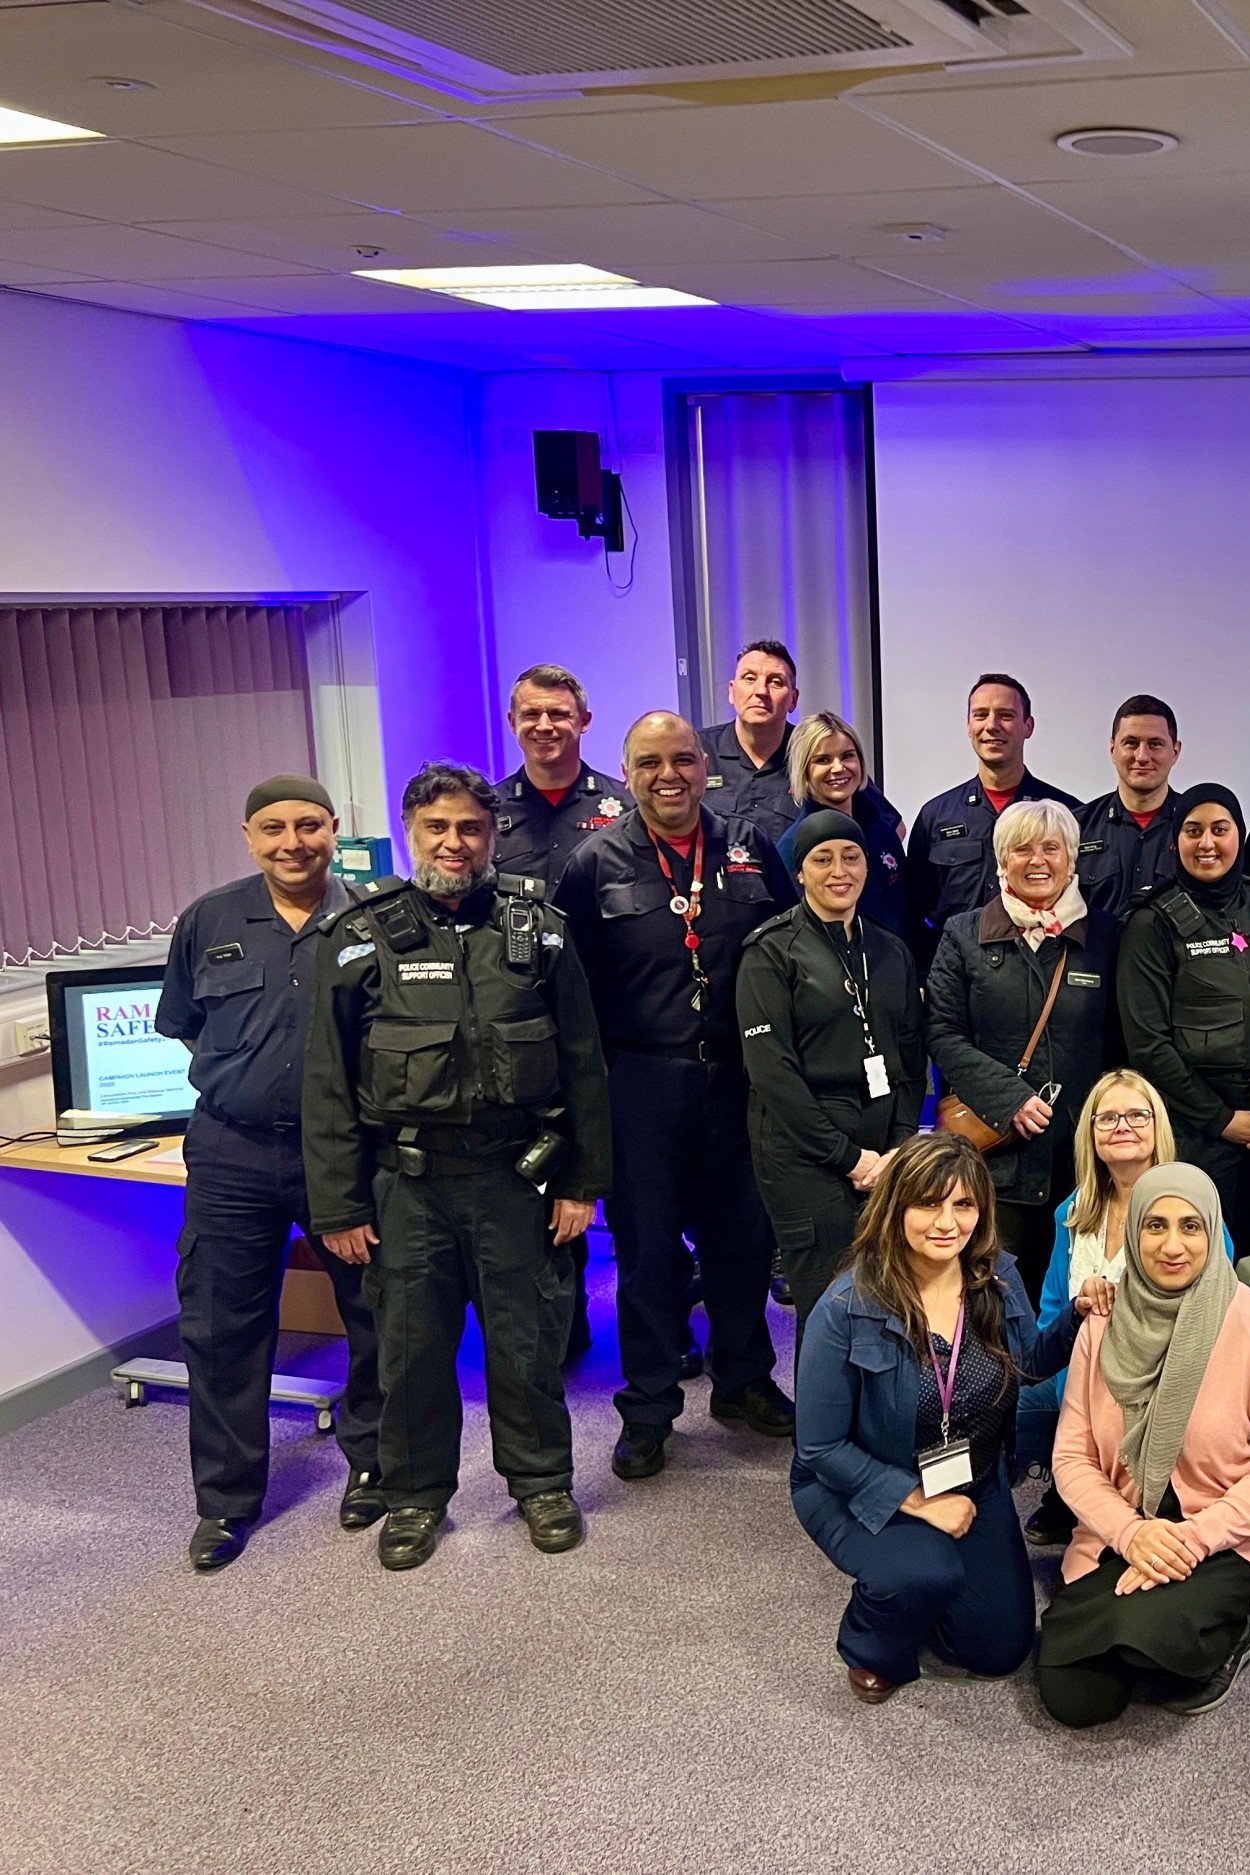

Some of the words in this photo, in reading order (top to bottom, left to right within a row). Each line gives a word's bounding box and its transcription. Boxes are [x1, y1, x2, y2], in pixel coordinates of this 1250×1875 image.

[96, 1019, 156, 1038] SAFE
[744, 1023, 772, 1038] POLICE
[98, 1037, 166, 1047] #RamadanSafety
